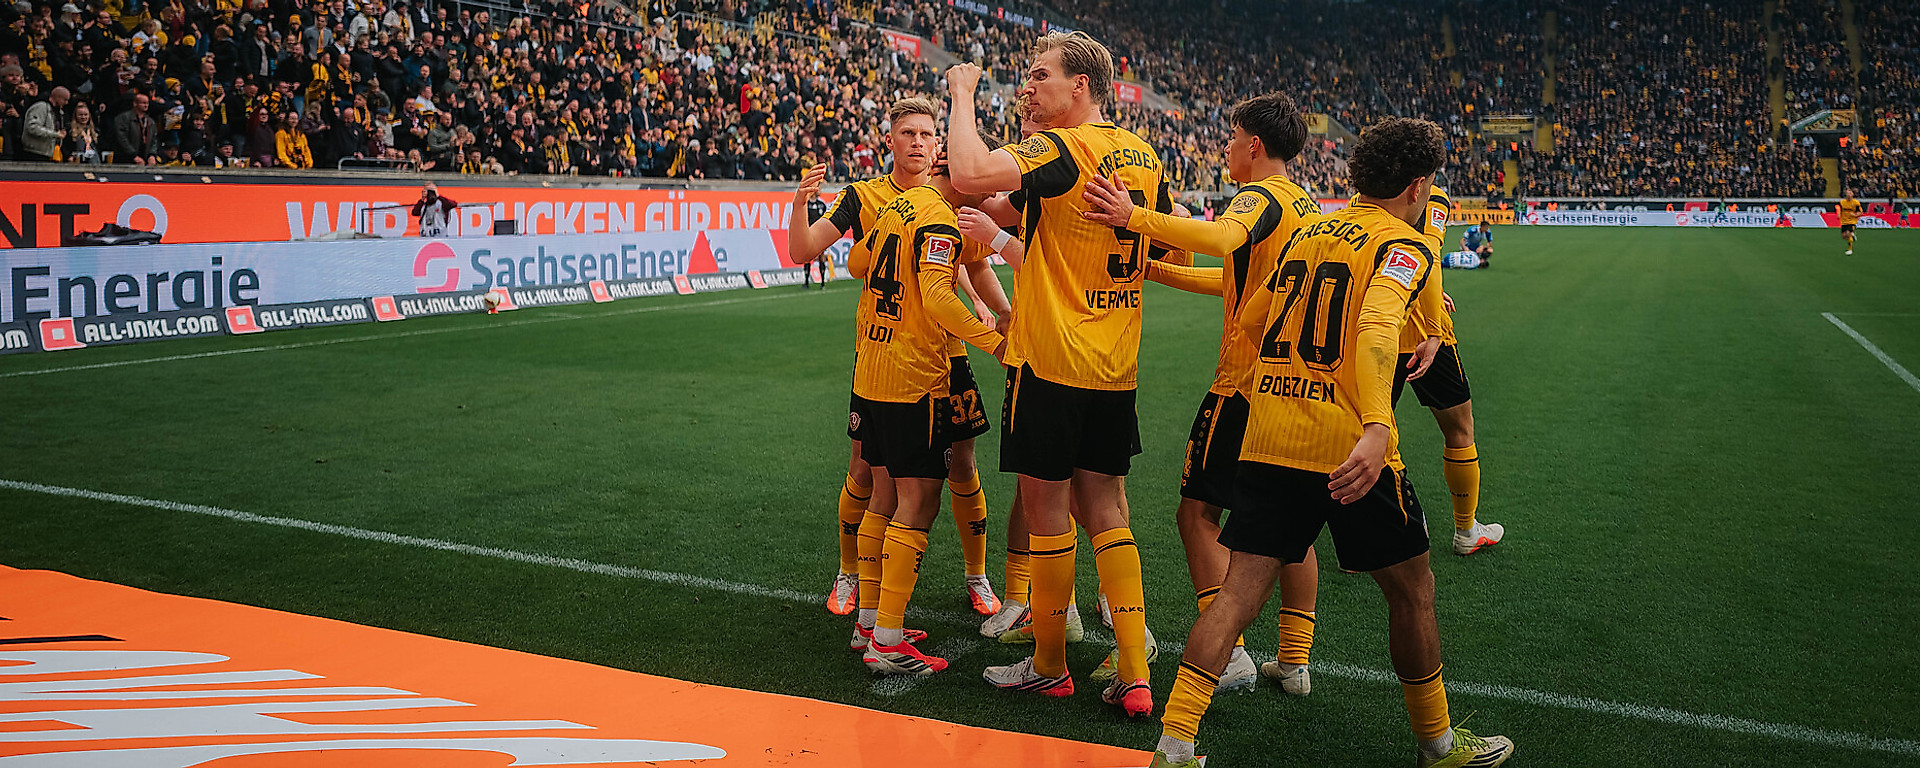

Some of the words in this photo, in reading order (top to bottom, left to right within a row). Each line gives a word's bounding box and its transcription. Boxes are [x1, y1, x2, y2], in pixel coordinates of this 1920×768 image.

[286, 202, 409, 240] WIR
[645, 191, 711, 235] FÜR
[1542, 213, 1639, 226] SachsenEnergie
[470, 243, 728, 290] SachsenEnere
[12, 256, 260, 318] Energie
[513, 286, 589, 306] ALL-INKL.COM
[609, 280, 675, 298] ALL-INKL.COM
[1085, 289, 1141, 310] VERME
[259, 303, 367, 328] ALL-INKL.COM
[400, 292, 485, 316] ALL-INKL.COM
[1259, 259, 1356, 373] 20
[83, 314, 219, 344] ALL-INKL.COM
[1257, 374, 1336, 404] BOBZIEN
[949, 388, 983, 426] 32
[1113, 605, 1144, 614] JAKO
